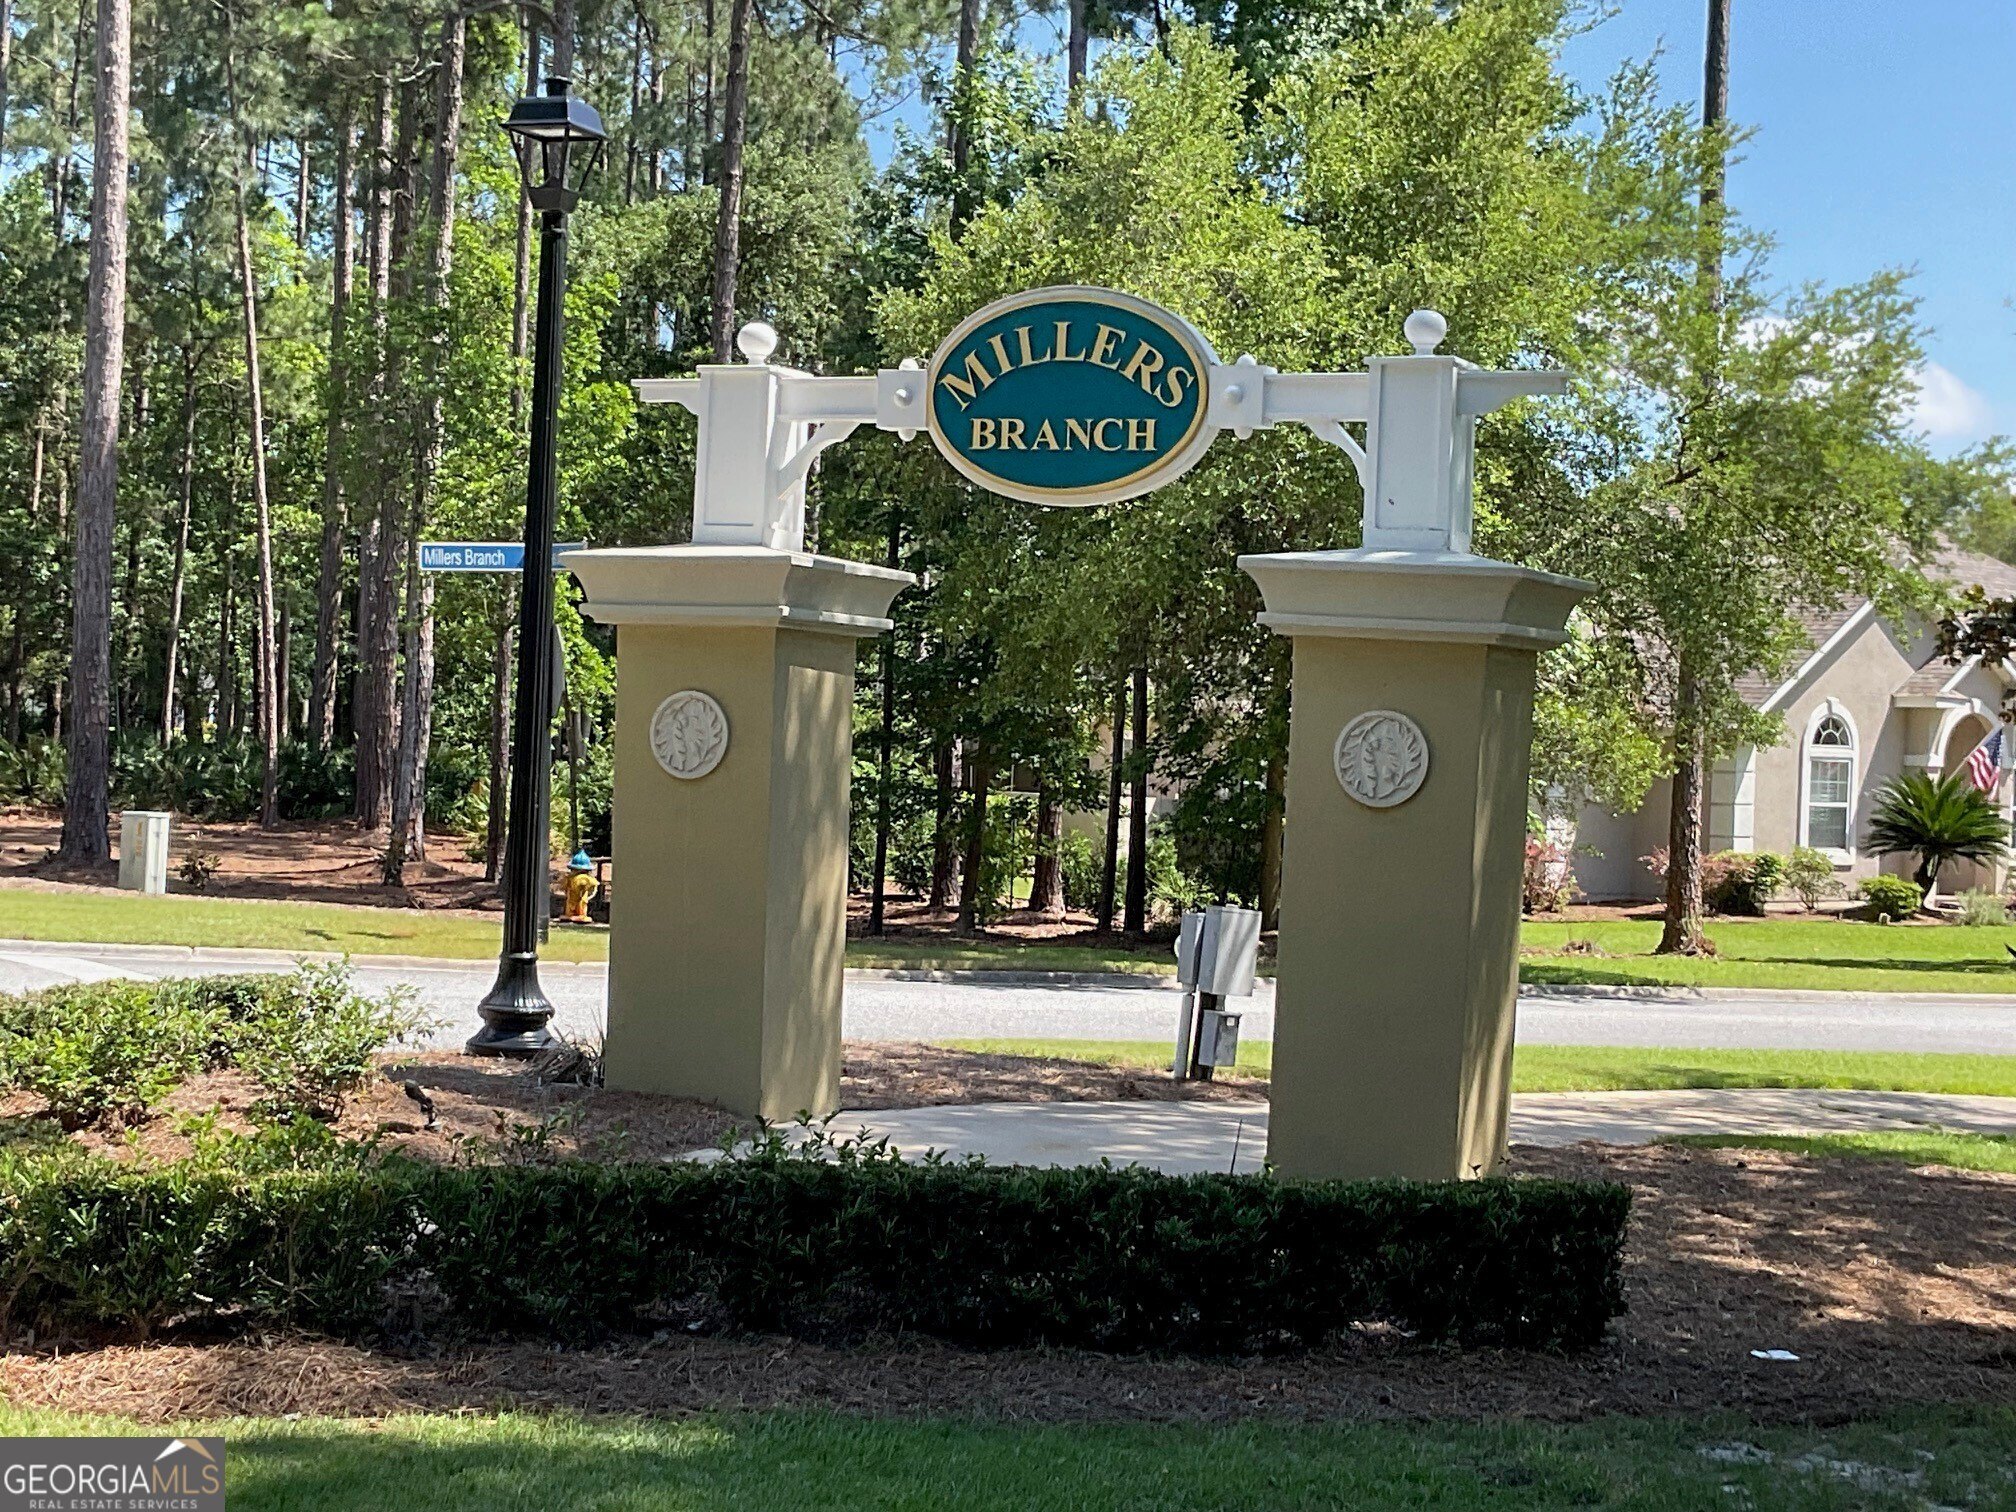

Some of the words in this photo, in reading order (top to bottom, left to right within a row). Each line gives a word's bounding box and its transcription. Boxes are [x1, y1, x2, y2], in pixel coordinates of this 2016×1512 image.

[939, 321, 1195, 412] MILLERS
[968, 418, 1158, 451] BRANCH
[424, 548, 462, 566] Millers
[465, 548, 505, 566] Branch
